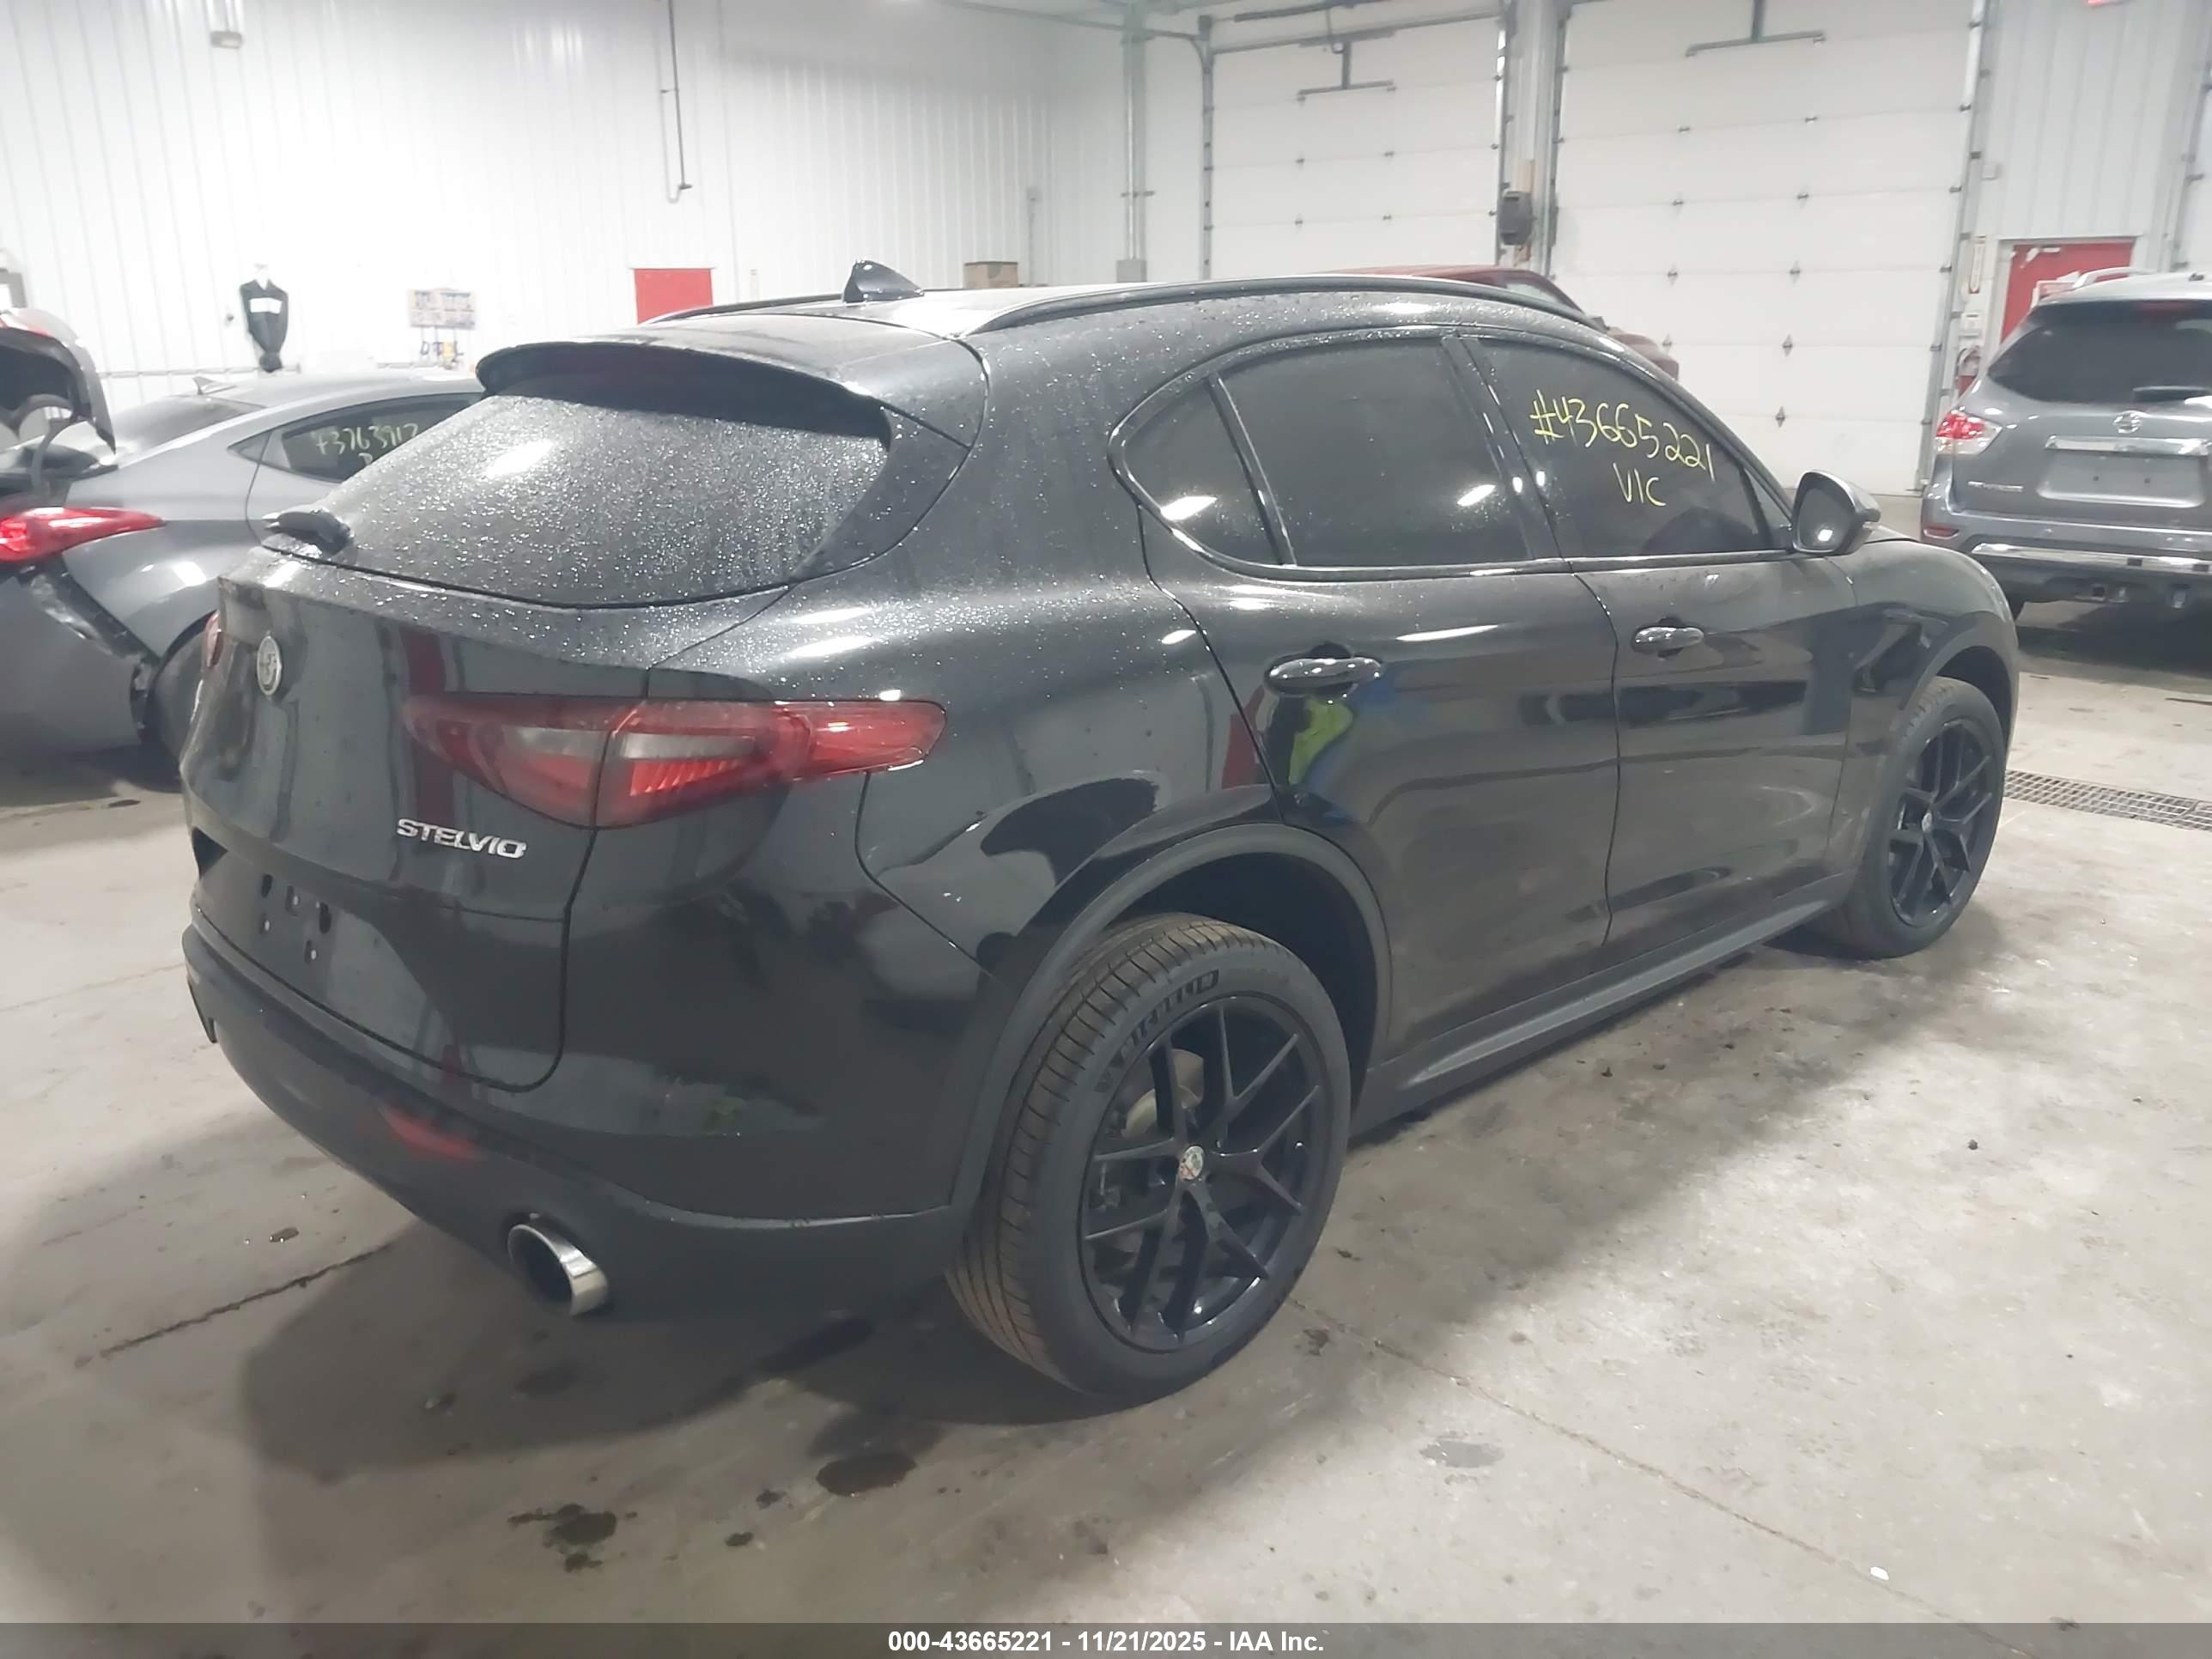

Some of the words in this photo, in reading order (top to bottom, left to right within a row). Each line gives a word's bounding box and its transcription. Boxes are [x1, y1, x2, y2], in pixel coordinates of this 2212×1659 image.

[1529, 389, 1716, 483] #43665221
[1613, 463, 1666, 507] VIC
[396, 817, 527, 859] STELVIO
